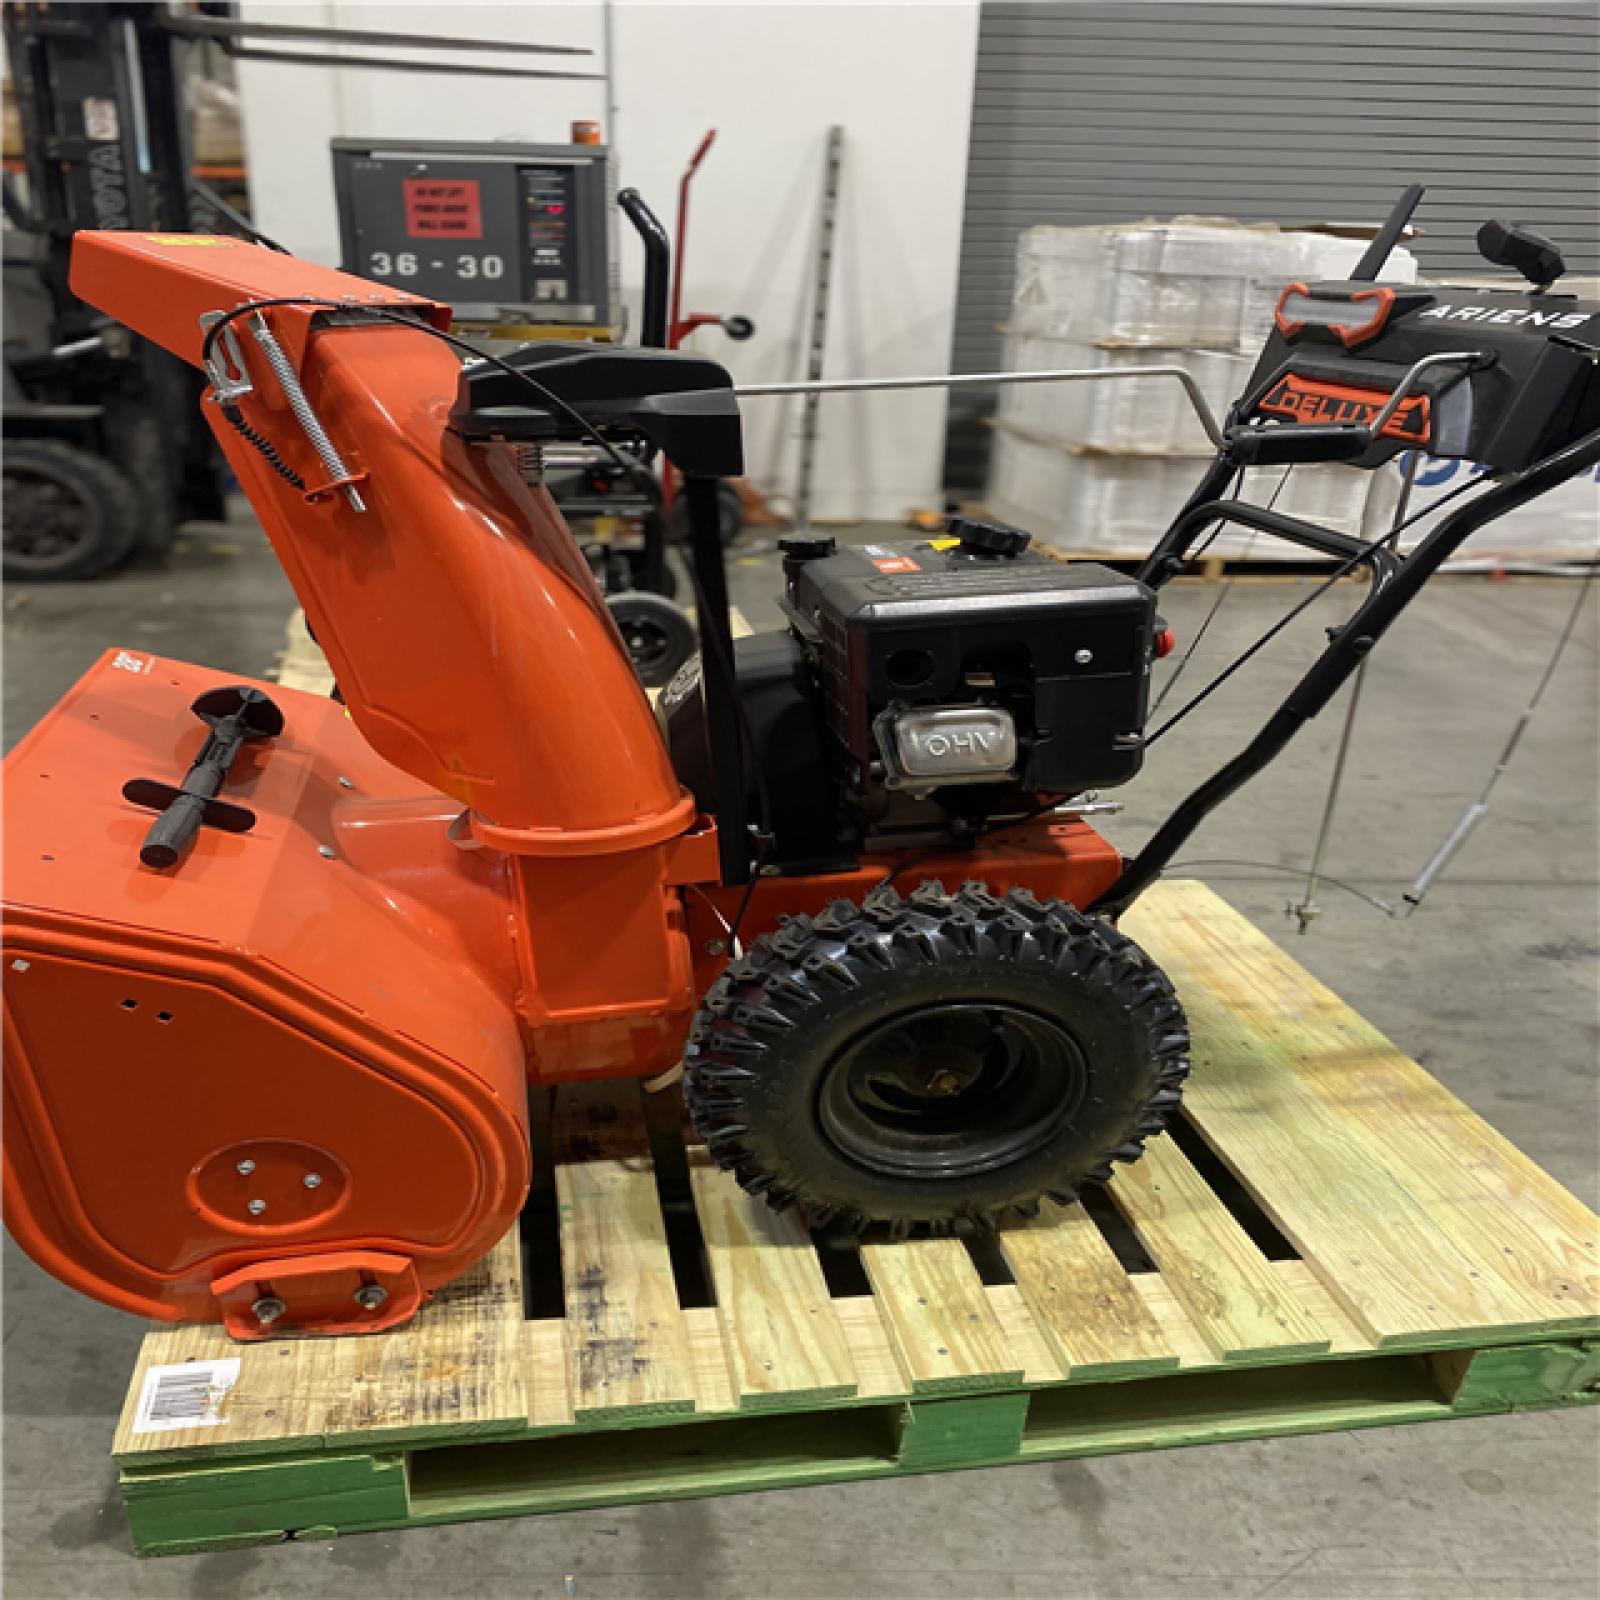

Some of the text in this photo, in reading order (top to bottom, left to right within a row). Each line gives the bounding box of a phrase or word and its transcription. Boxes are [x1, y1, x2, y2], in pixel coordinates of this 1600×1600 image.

[369, 252, 419, 276] 36
[456, 254, 504, 279] 30
[1418, 304, 1592, 329] ARIENS
[926, 731, 997, 757] OHV
